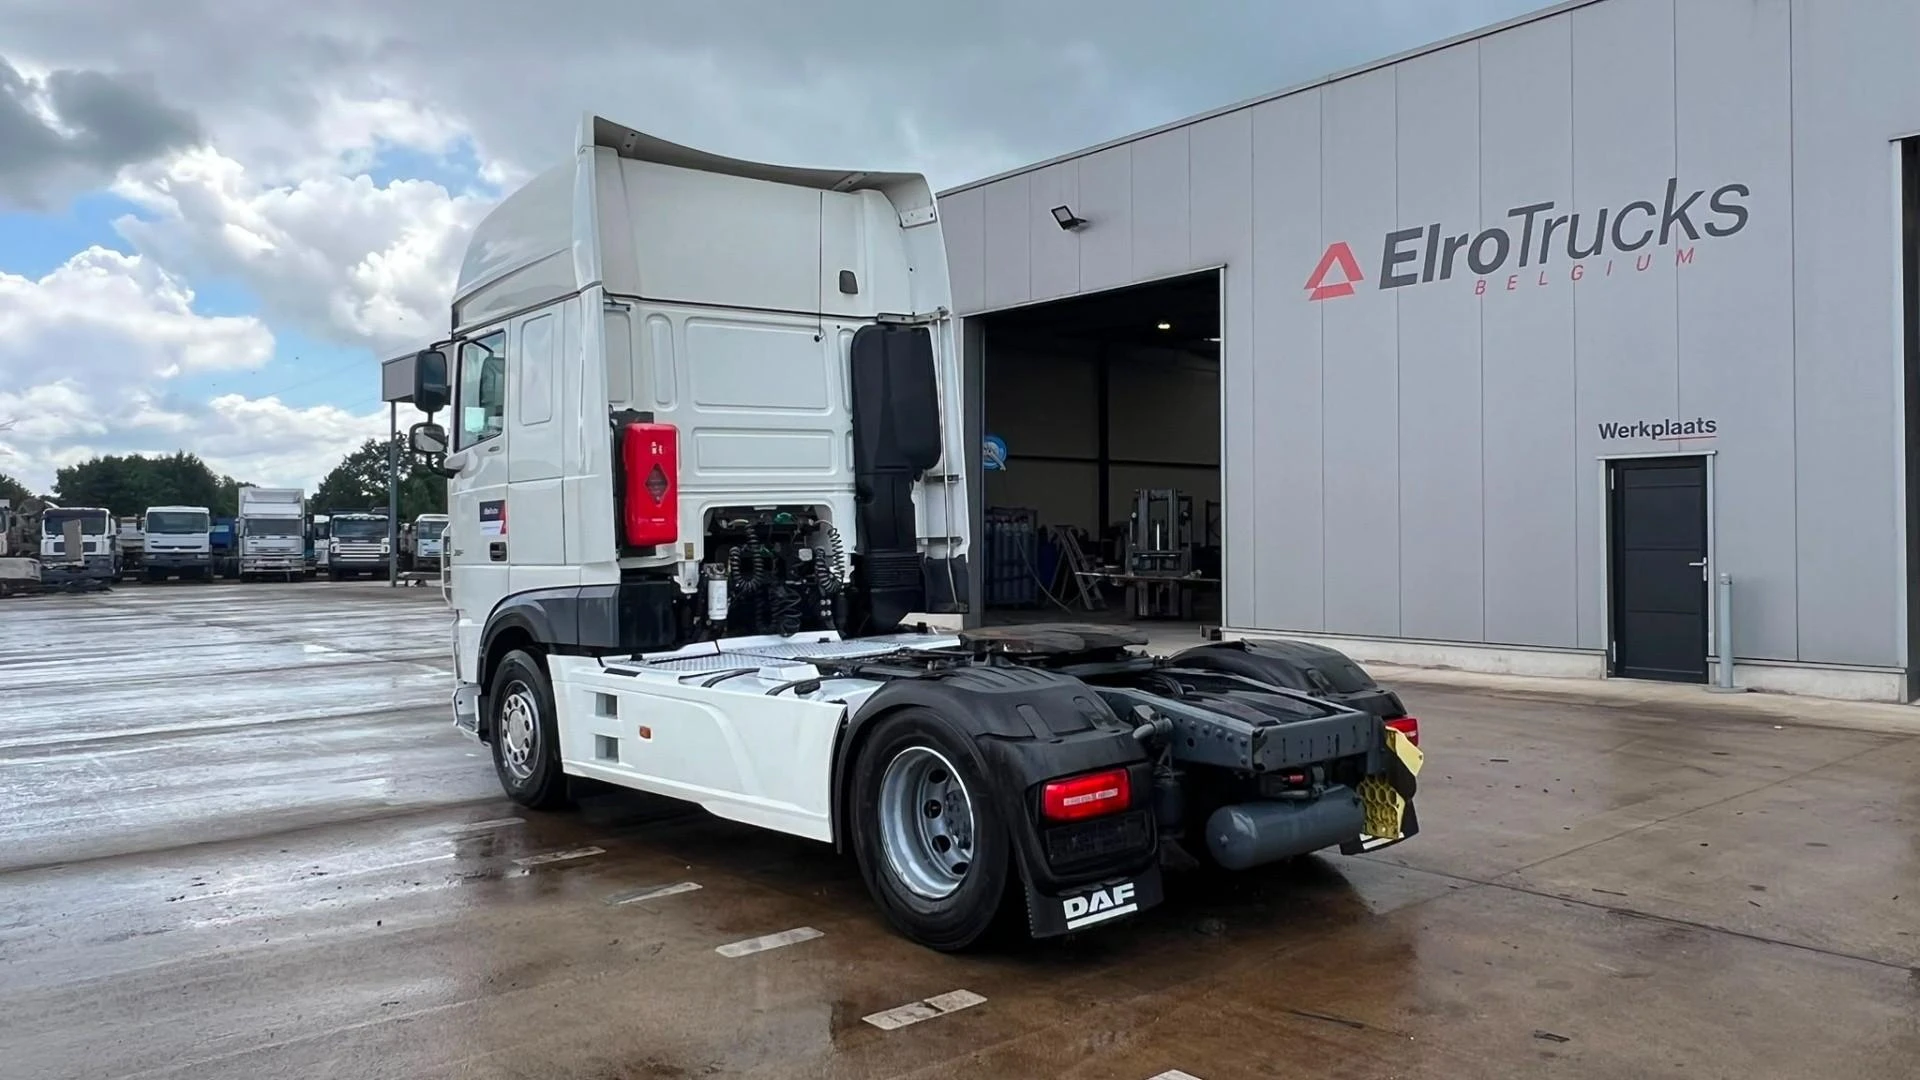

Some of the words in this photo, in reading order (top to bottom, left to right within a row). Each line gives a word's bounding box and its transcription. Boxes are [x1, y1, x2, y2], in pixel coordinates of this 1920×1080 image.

[1379, 178, 1750, 290] ElroTrucks
[1475, 247, 1694, 296] BELGIUM
[1599, 418, 1717, 440] Werkplaats
[1063, 883, 1135, 920] DAF
